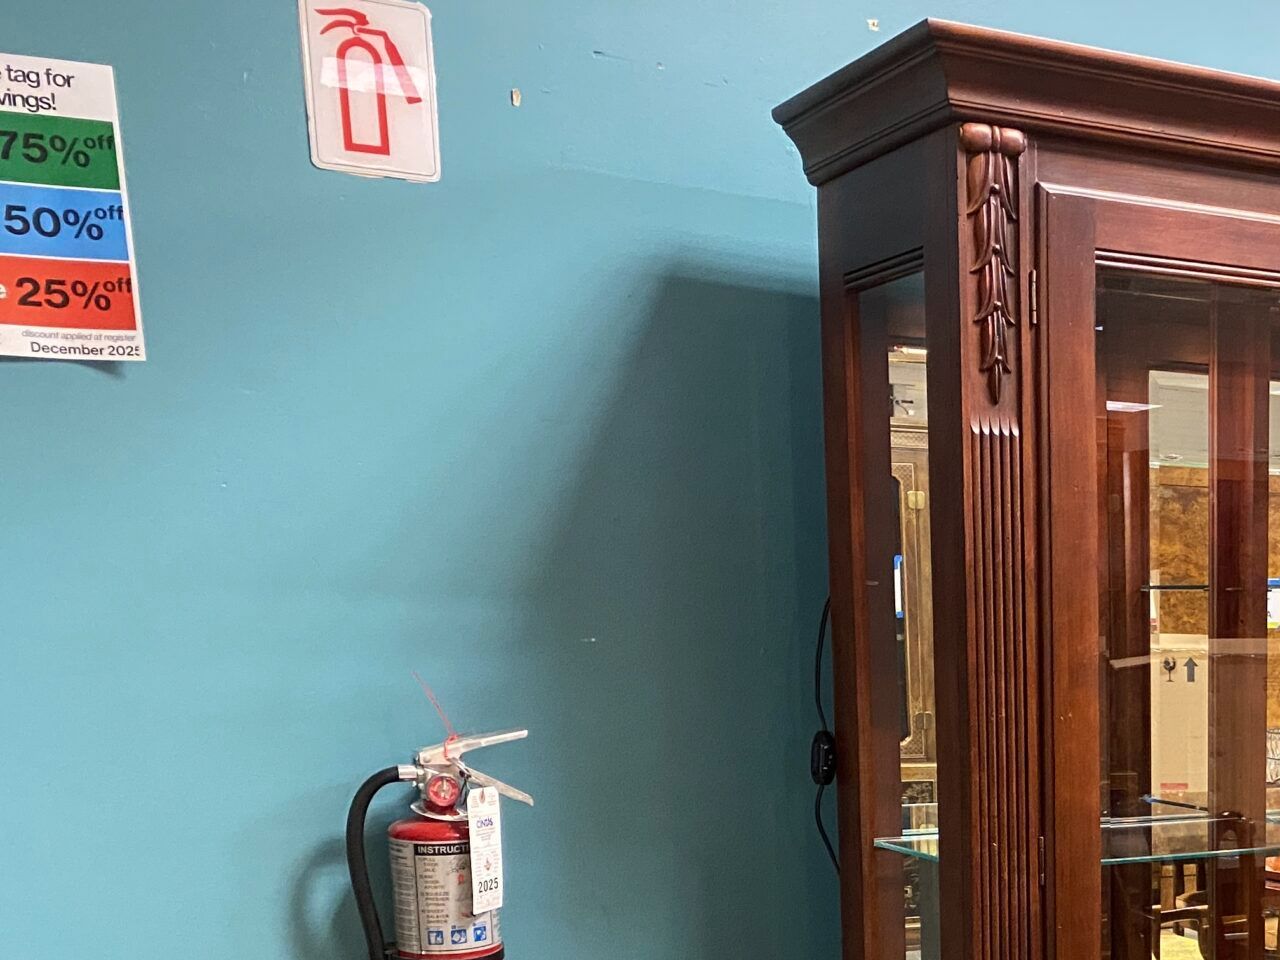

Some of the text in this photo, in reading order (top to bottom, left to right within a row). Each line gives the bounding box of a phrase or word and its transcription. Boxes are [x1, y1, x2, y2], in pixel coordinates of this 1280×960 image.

[5, 65, 75, 88] tag for
[4, 204, 103, 240] 50%
[16, 277, 112, 311] 25%
[22, 329, 59, 340] discount
[61, 332, 92, 341] applied
[104, 334, 136, 342] register
[30, 341, 105, 356] December
[478, 877, 499, 894] 2025
